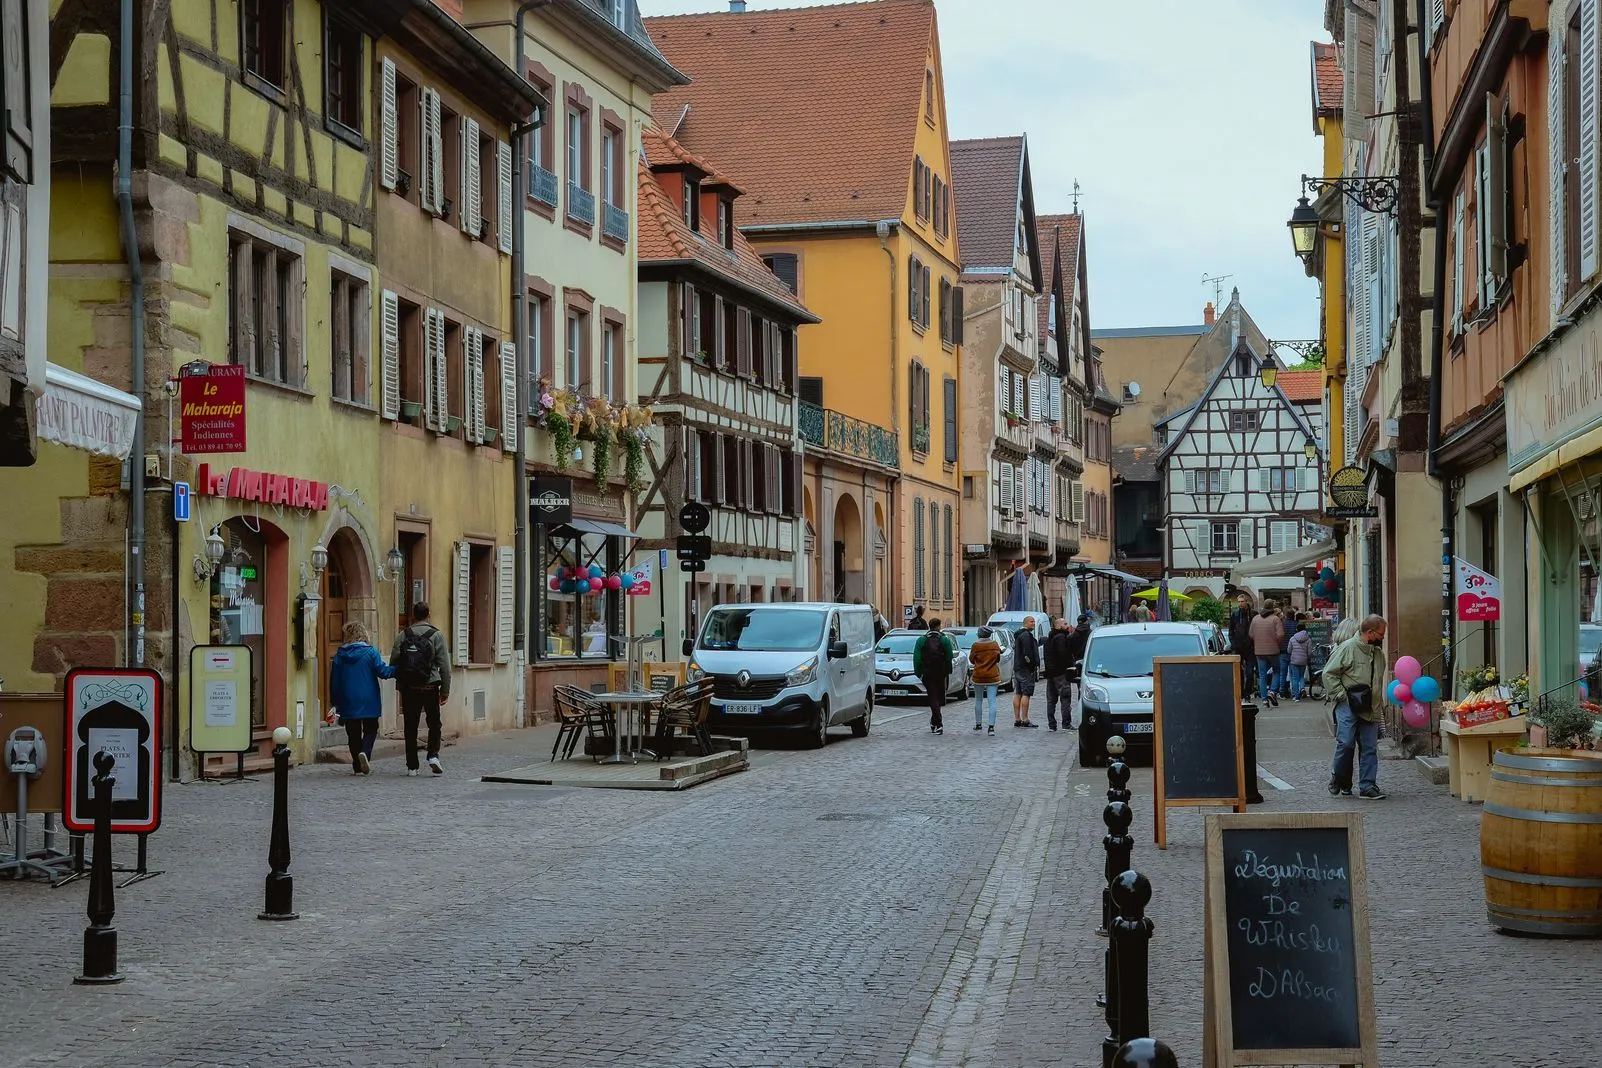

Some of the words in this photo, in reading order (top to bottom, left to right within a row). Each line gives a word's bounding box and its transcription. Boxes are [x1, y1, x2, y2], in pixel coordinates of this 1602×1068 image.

[204, 382, 218, 396] Le
[183, 401, 243, 418] Maharaja
[191, 420, 235, 430] Spécialités
[193, 431, 233, 440] Indiennes
[1234, 850, 1347, 887] Dégustation
[1262, 893, 1301, 915] De
[1238, 917, 1342, 967] Whisky
